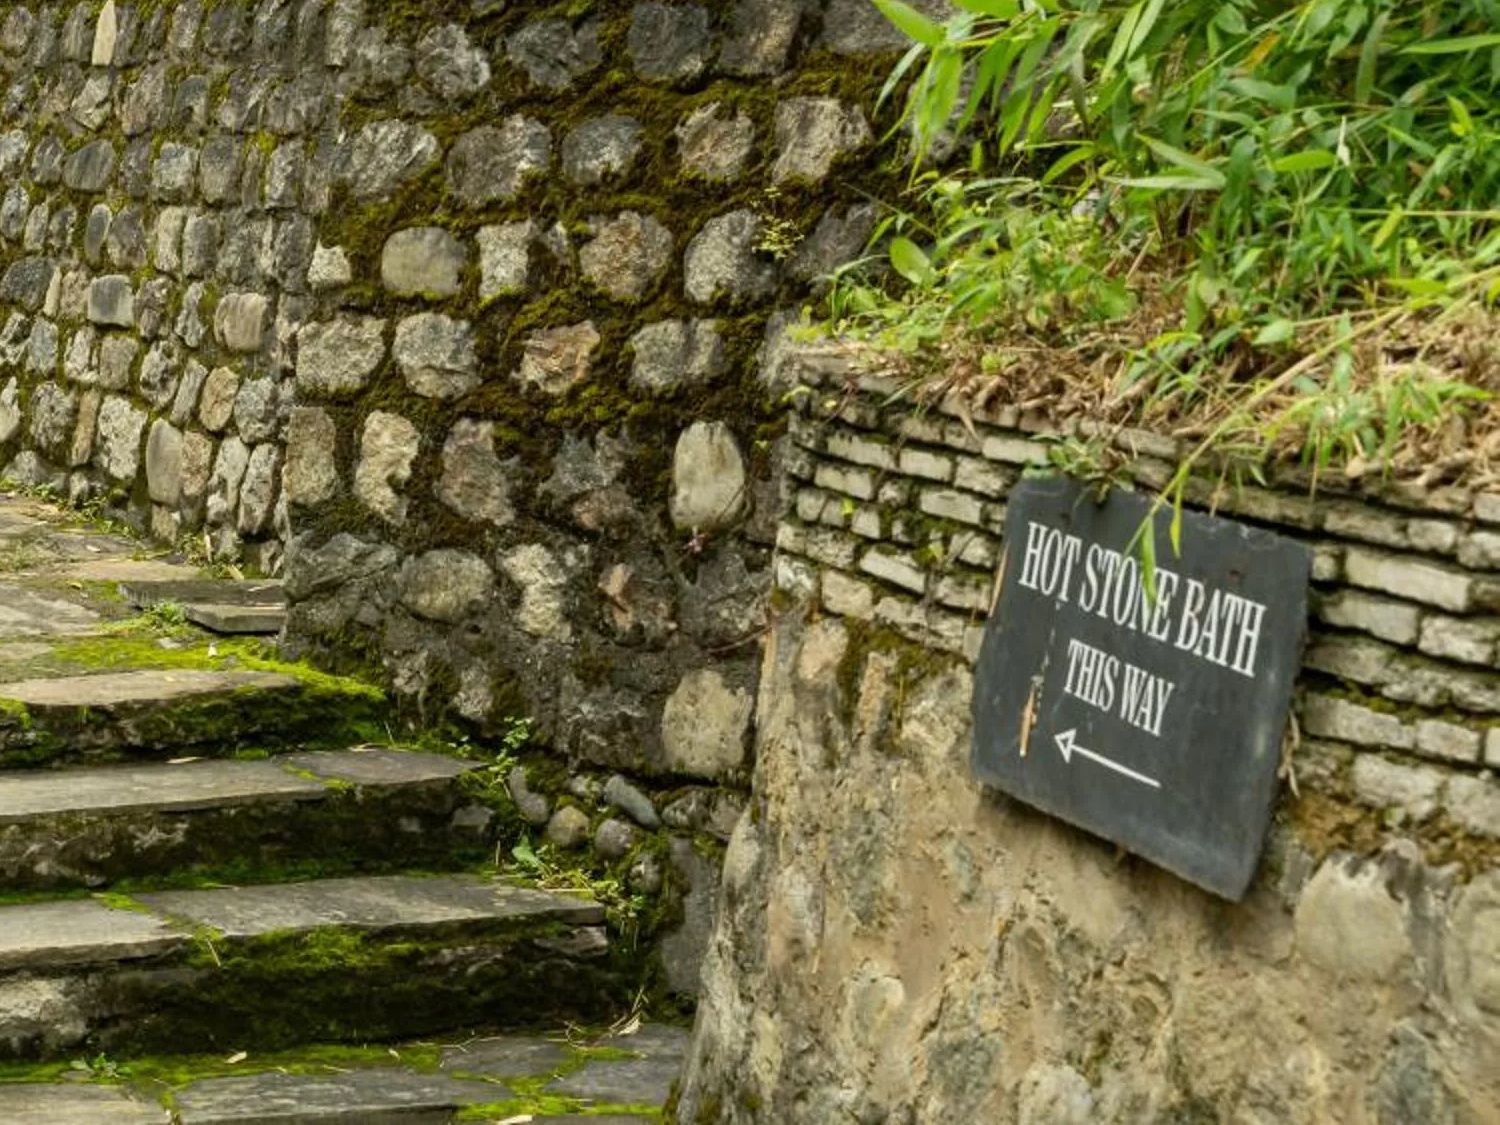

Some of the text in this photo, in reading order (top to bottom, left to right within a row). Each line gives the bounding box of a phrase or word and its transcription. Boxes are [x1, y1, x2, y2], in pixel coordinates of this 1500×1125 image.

[1017, 521, 1082, 603] HOT
[1173, 578, 1268, 678] BATH
[1063, 638, 1175, 737] THIS WAY
